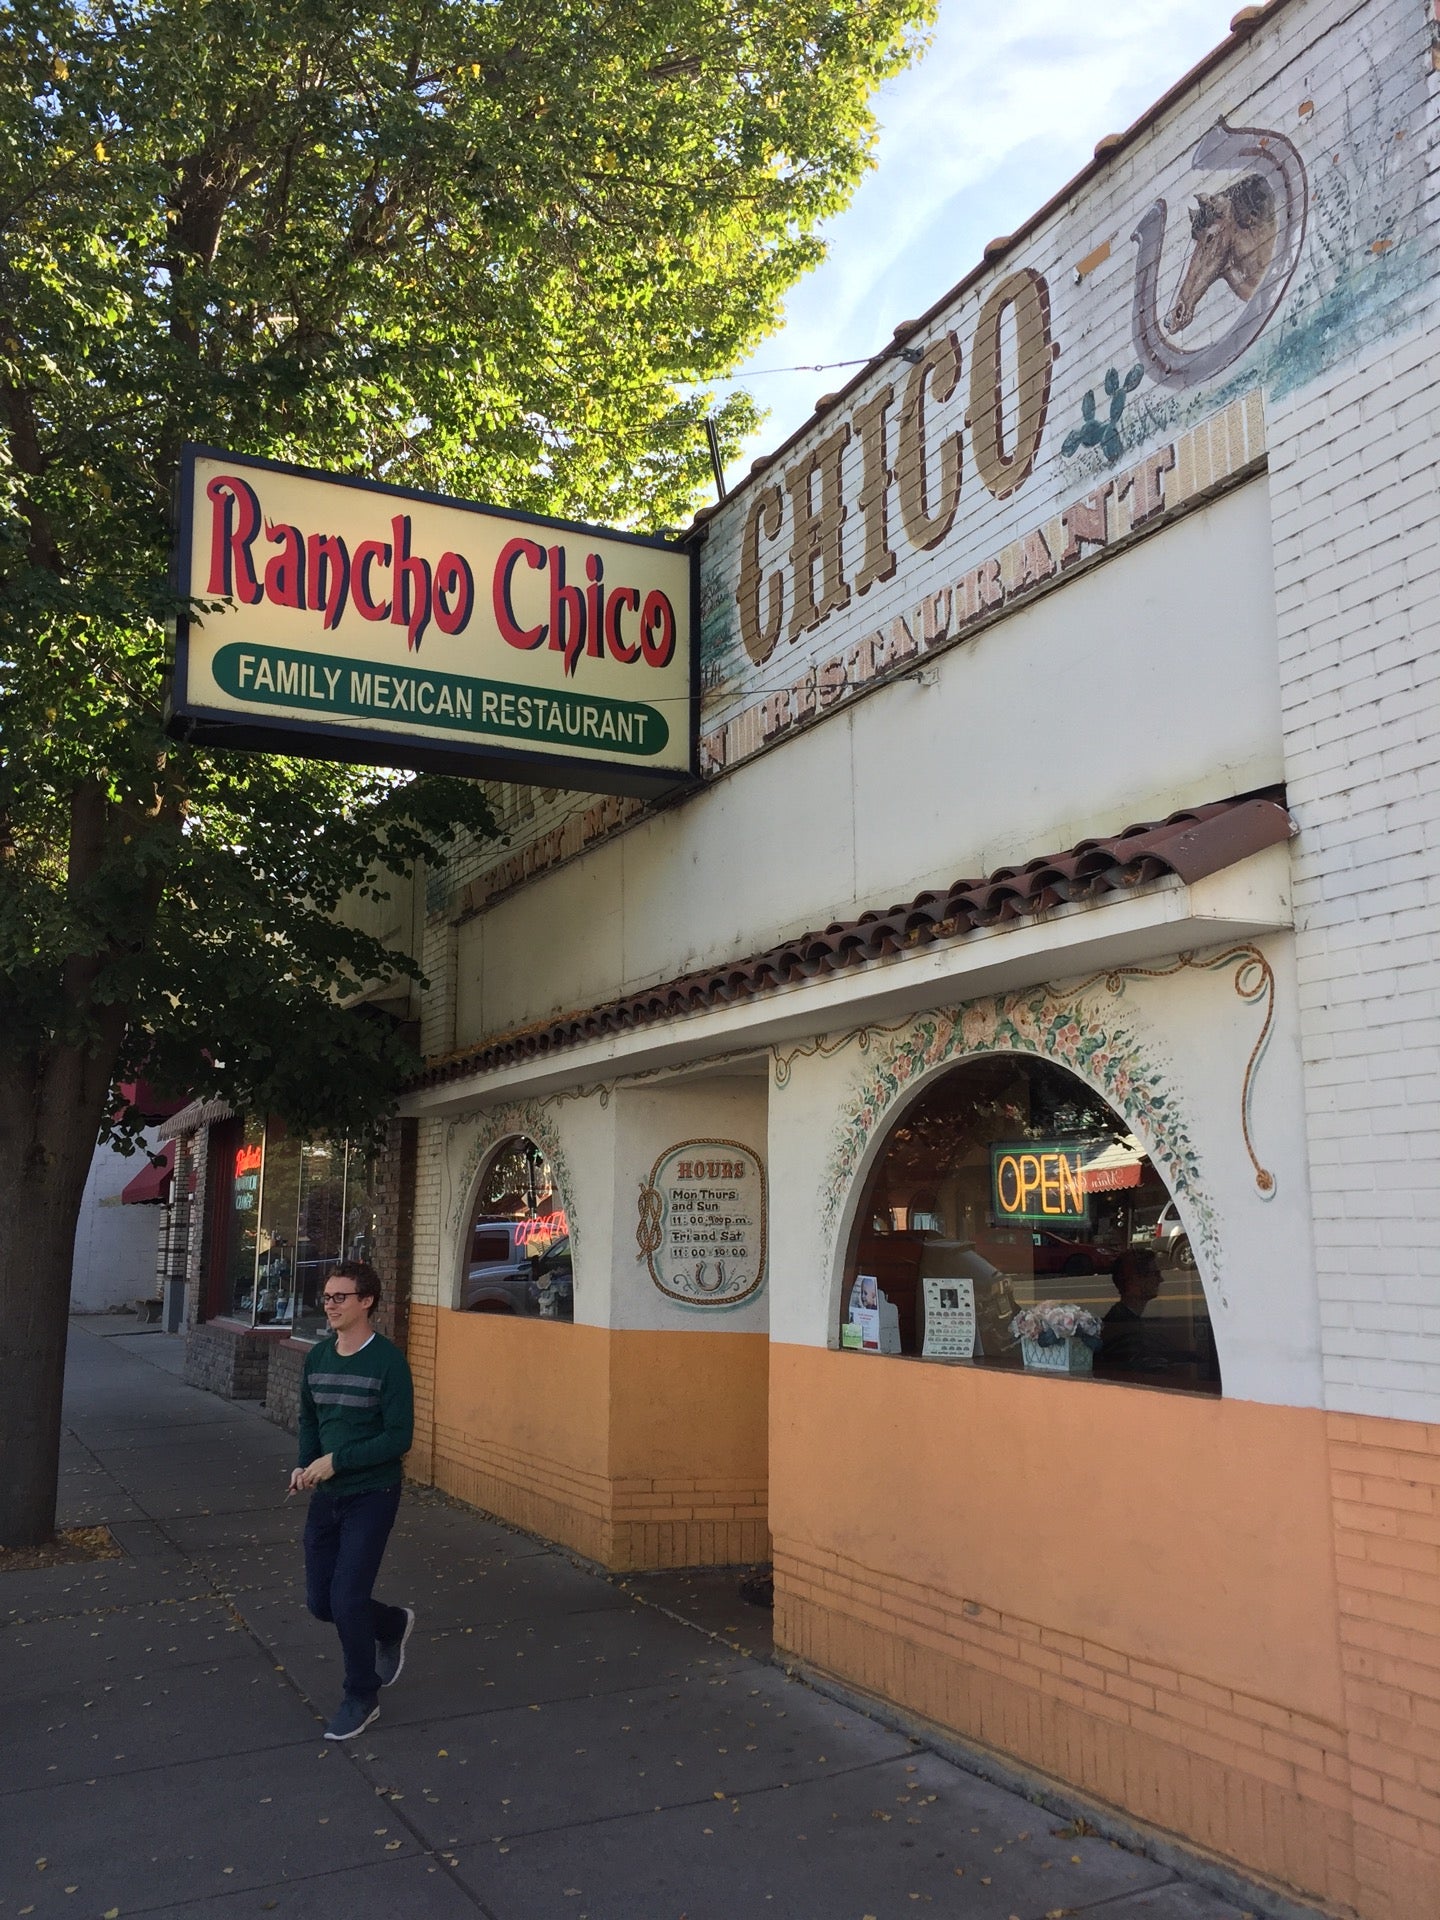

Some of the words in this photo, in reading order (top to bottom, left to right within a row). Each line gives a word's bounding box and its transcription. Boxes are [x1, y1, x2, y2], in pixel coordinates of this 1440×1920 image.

[736, 267, 1060, 667] CHICO
[206, 475, 474, 653] Rancho
[493, 537, 677, 678] Chico
[761, 443, 1176, 743] RESTAURANT
[238, 655, 343, 702] FAMILY
[350, 671, 473, 721] MEXICAN
[481, 690, 649, 745] RESTAURANT
[672, 1190, 698, 1200] Mon
[699, 1189, 736, 1200] Thurs
[677, 1160, 746, 1180] HOURS
[998, 1153, 1084, 1214] OPEN
[671, 1201, 693, 1211] and
[696, 1201, 719, 1211] Sun
[671, 1229, 690, 1241] Fri
[693, 1231, 716, 1241] and
[720, 1231, 742, 1241] Sat
